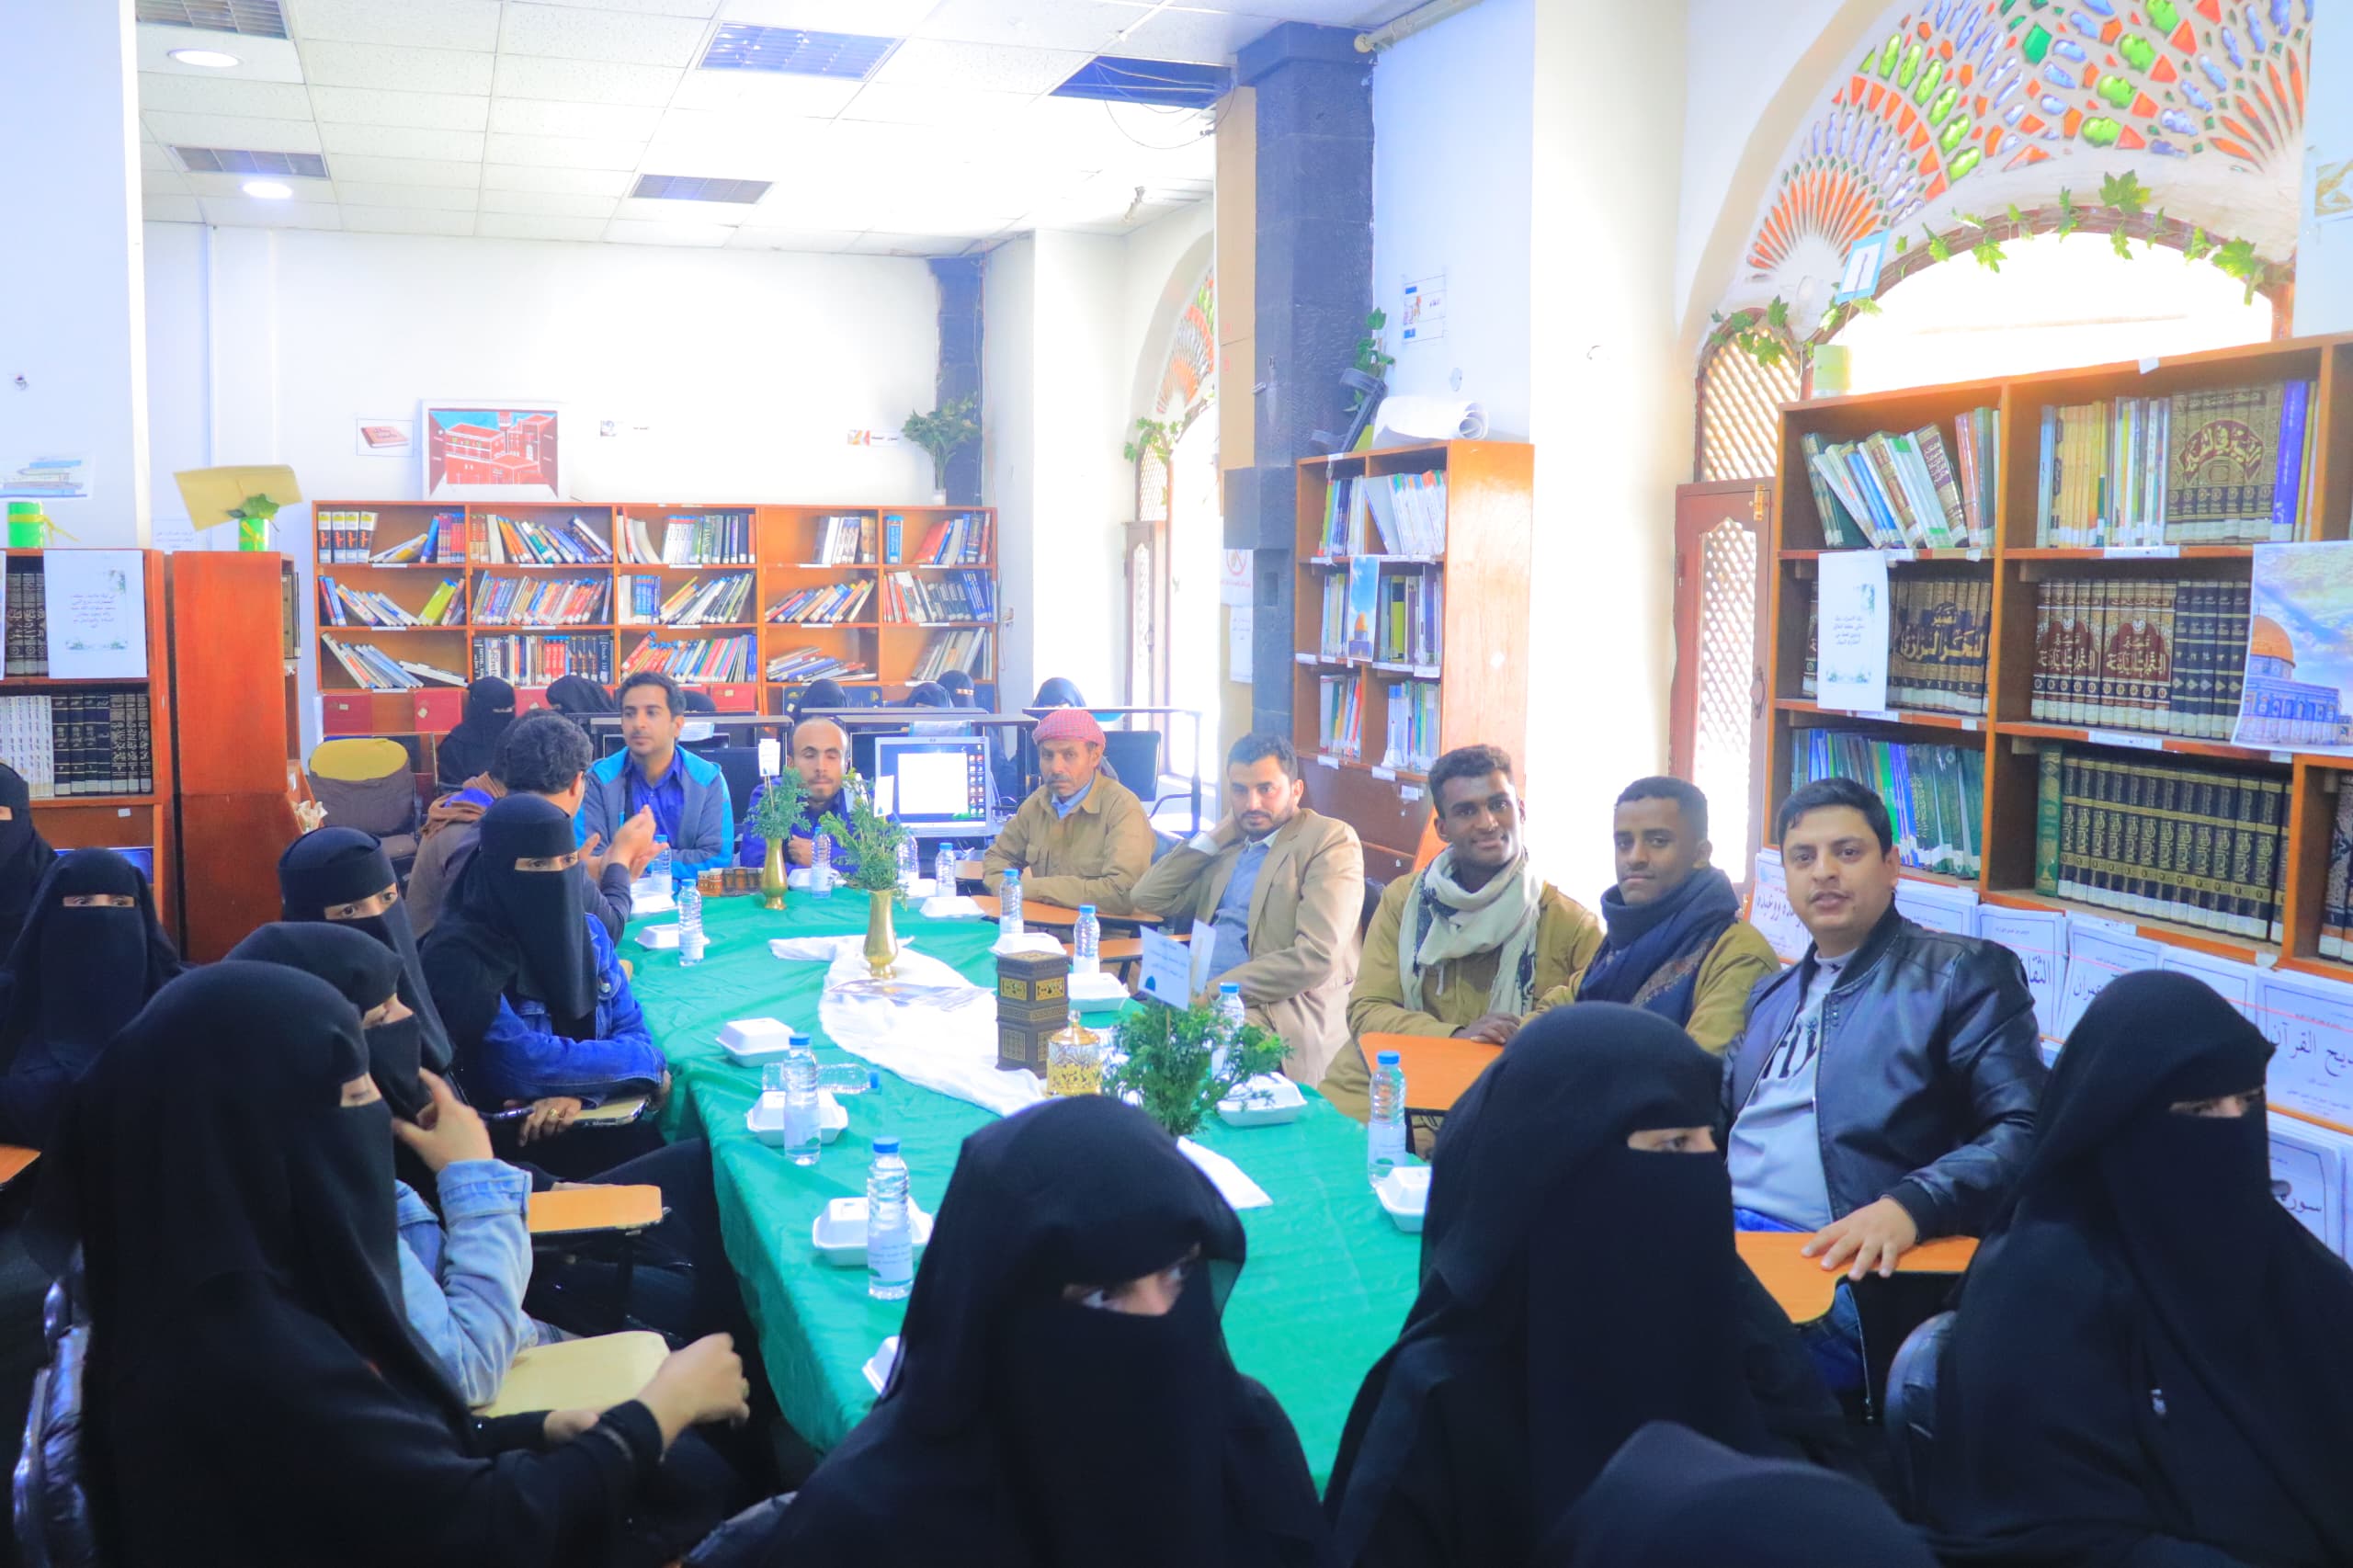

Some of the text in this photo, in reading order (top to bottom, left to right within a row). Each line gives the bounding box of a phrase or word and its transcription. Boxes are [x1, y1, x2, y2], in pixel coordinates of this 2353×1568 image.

[1933, 614, 1957, 627] تفسير
[2027, 954, 2051, 984] الثقا
[2271, 1021, 2317, 1060] القرآن
